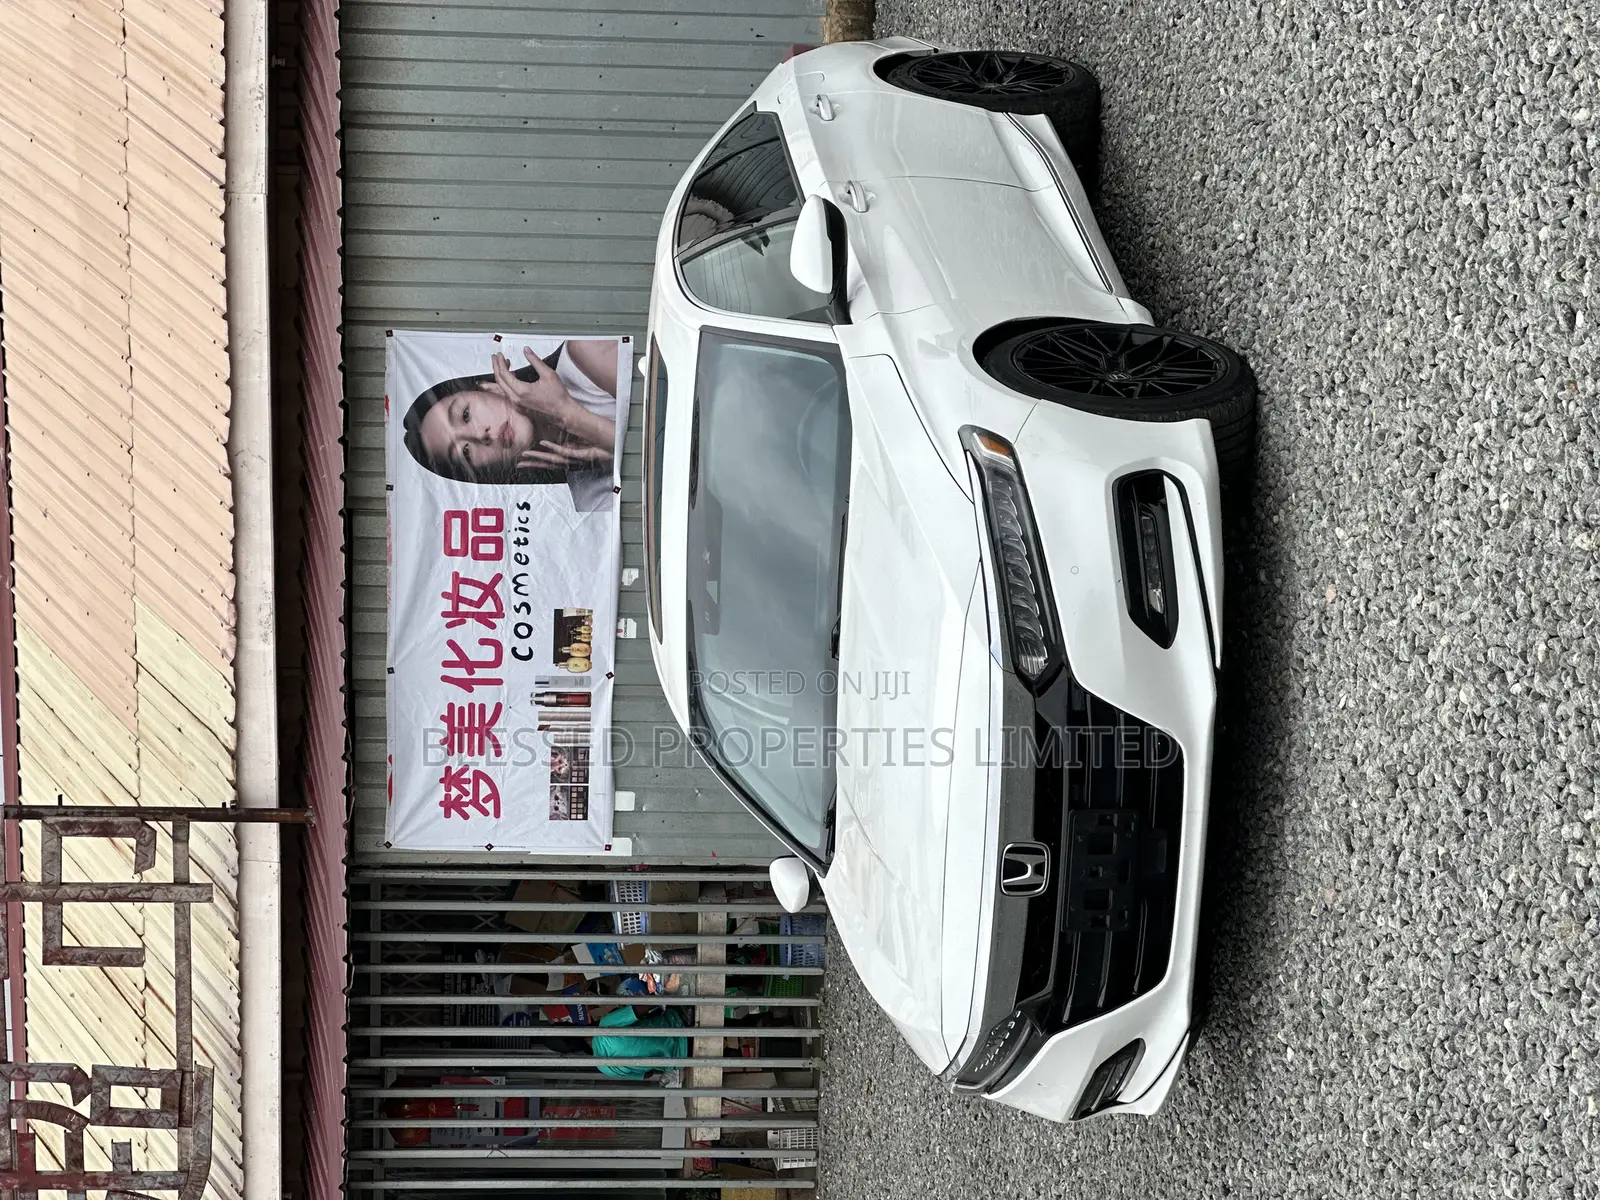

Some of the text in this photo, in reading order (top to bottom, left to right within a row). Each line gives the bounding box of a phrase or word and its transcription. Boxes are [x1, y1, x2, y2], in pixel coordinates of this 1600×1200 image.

[439, 507, 505, 820] 梦美化妆品
